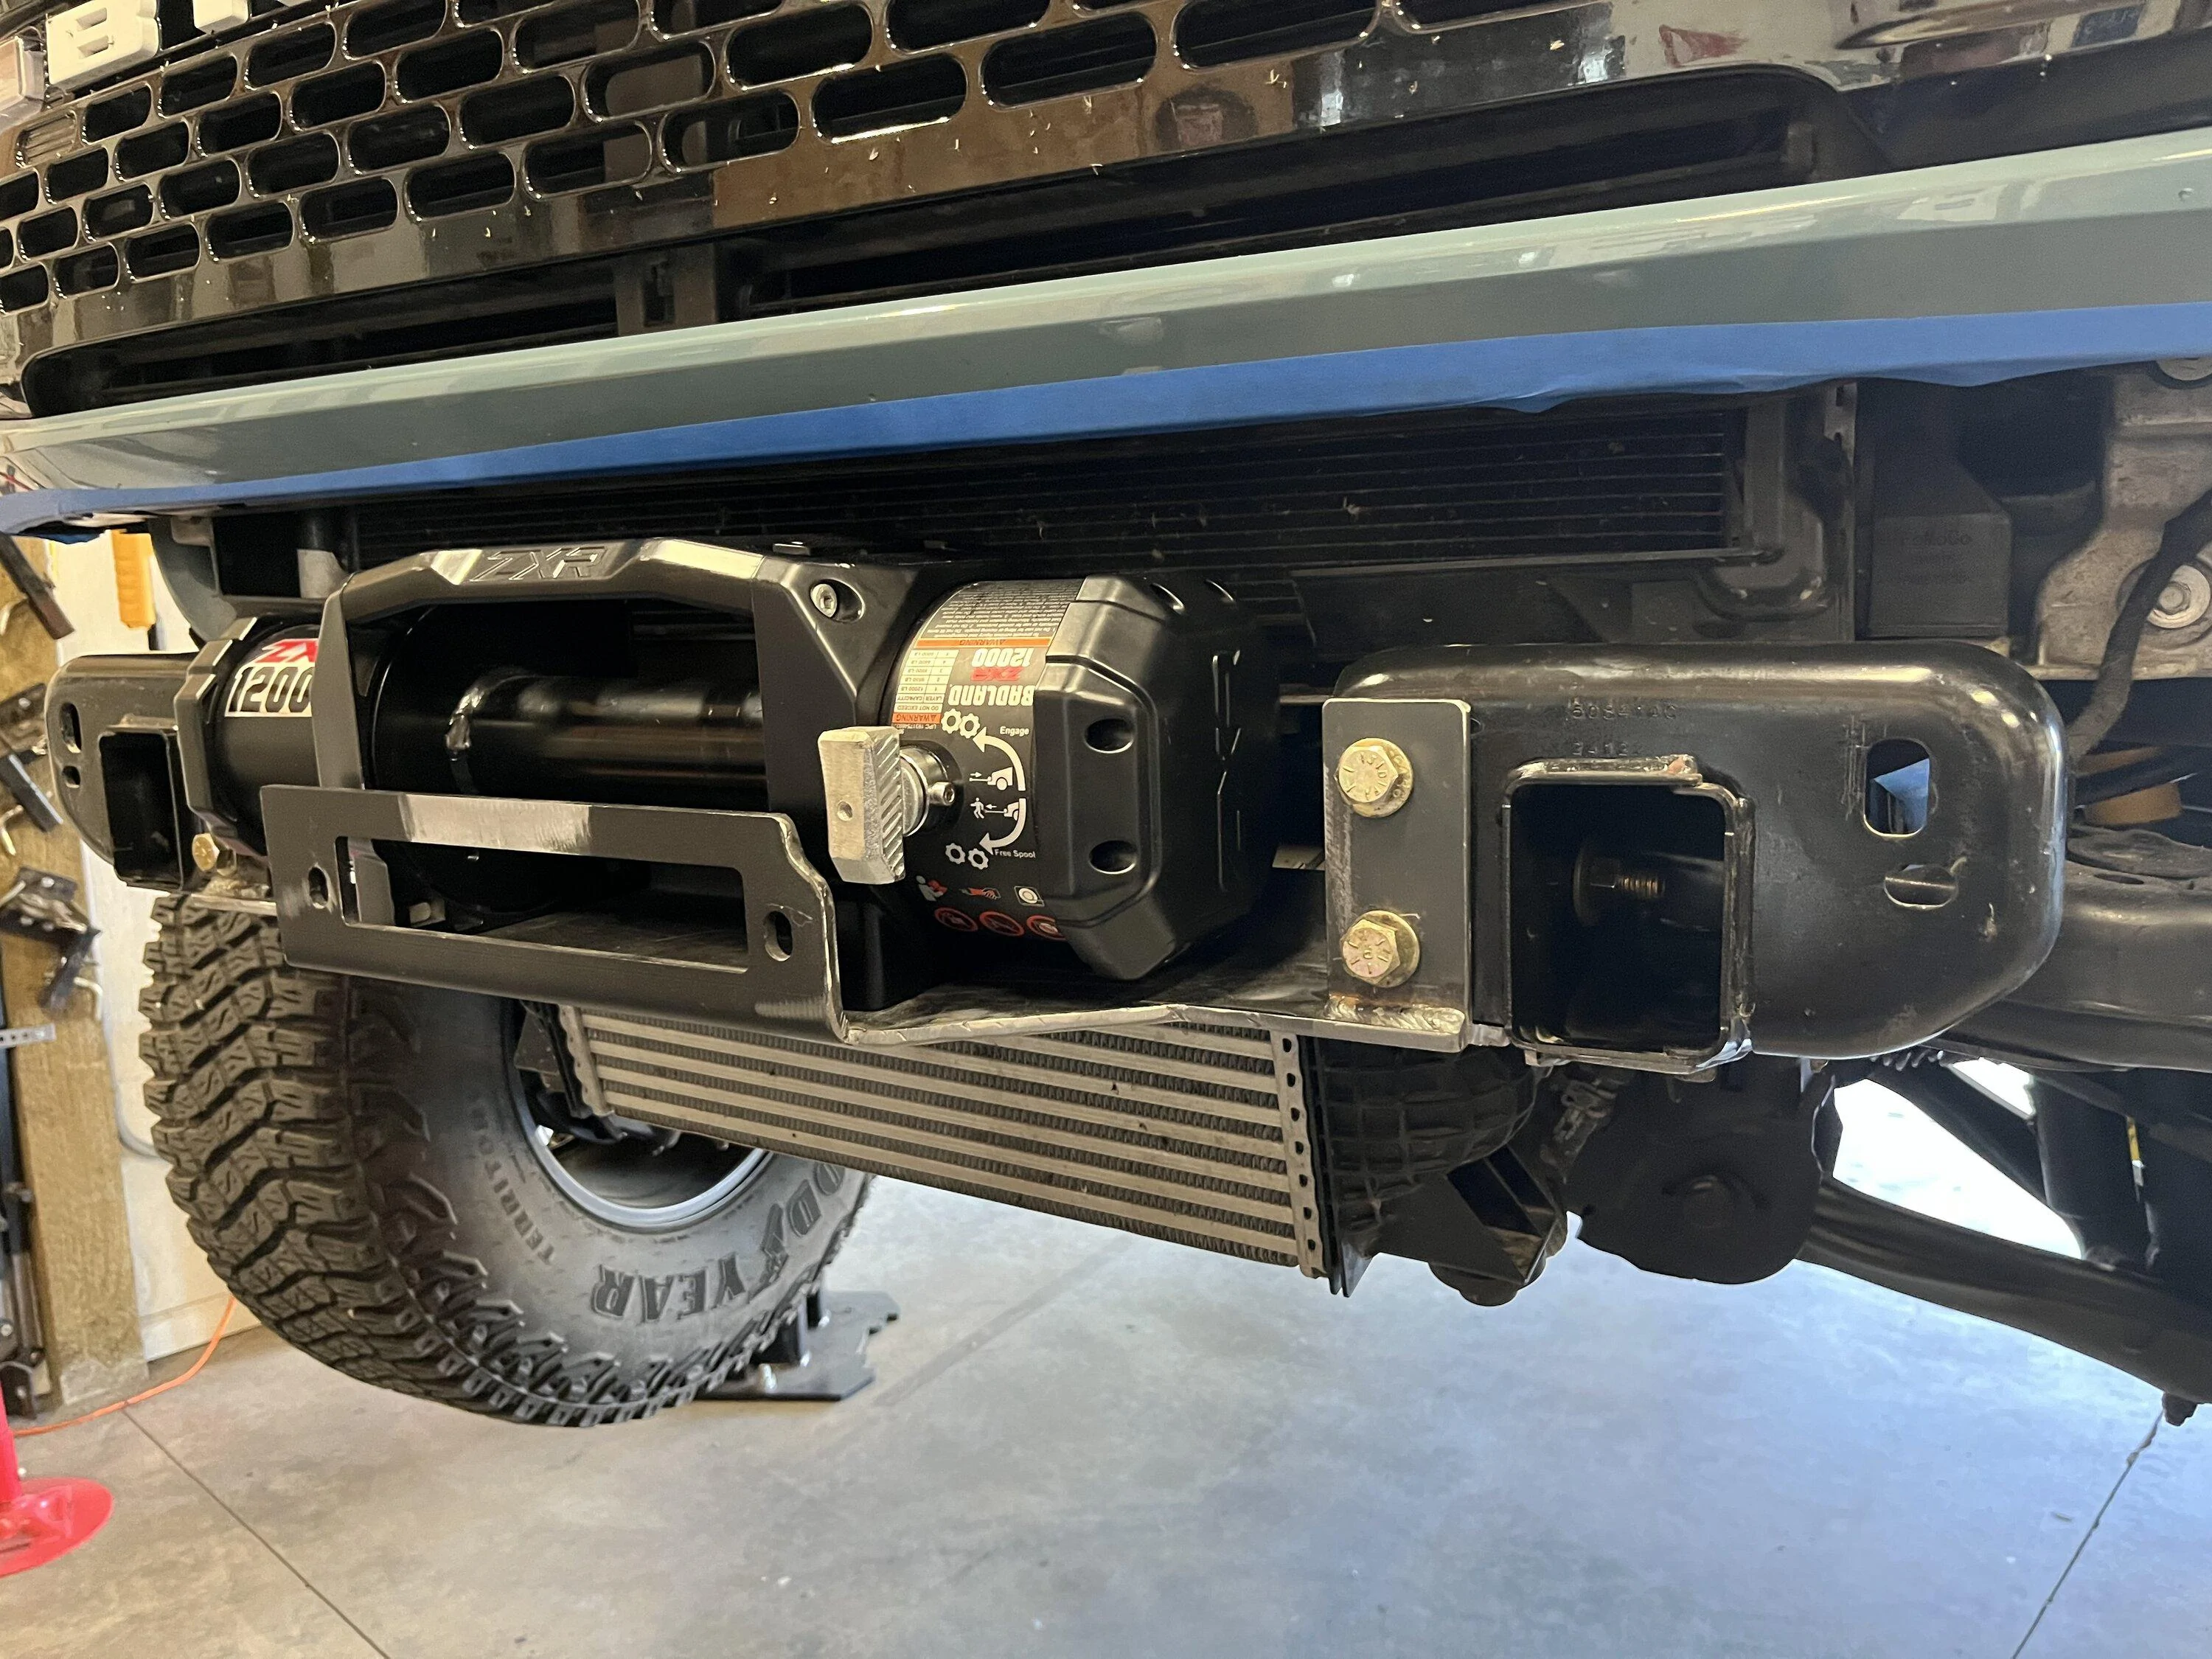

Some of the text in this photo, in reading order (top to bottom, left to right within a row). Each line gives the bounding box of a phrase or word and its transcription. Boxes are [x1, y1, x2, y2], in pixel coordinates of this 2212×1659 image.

[469, 546, 606, 582] ZXR
[972, 648, 1034, 667] 12000
[970, 667, 1024, 681] ZXR
[947, 685, 1034, 706] BADLAND
[896, 714, 930, 722] WARNING
[999, 726, 1030, 737] Engage
[994, 849, 1036, 859] Free Spool
